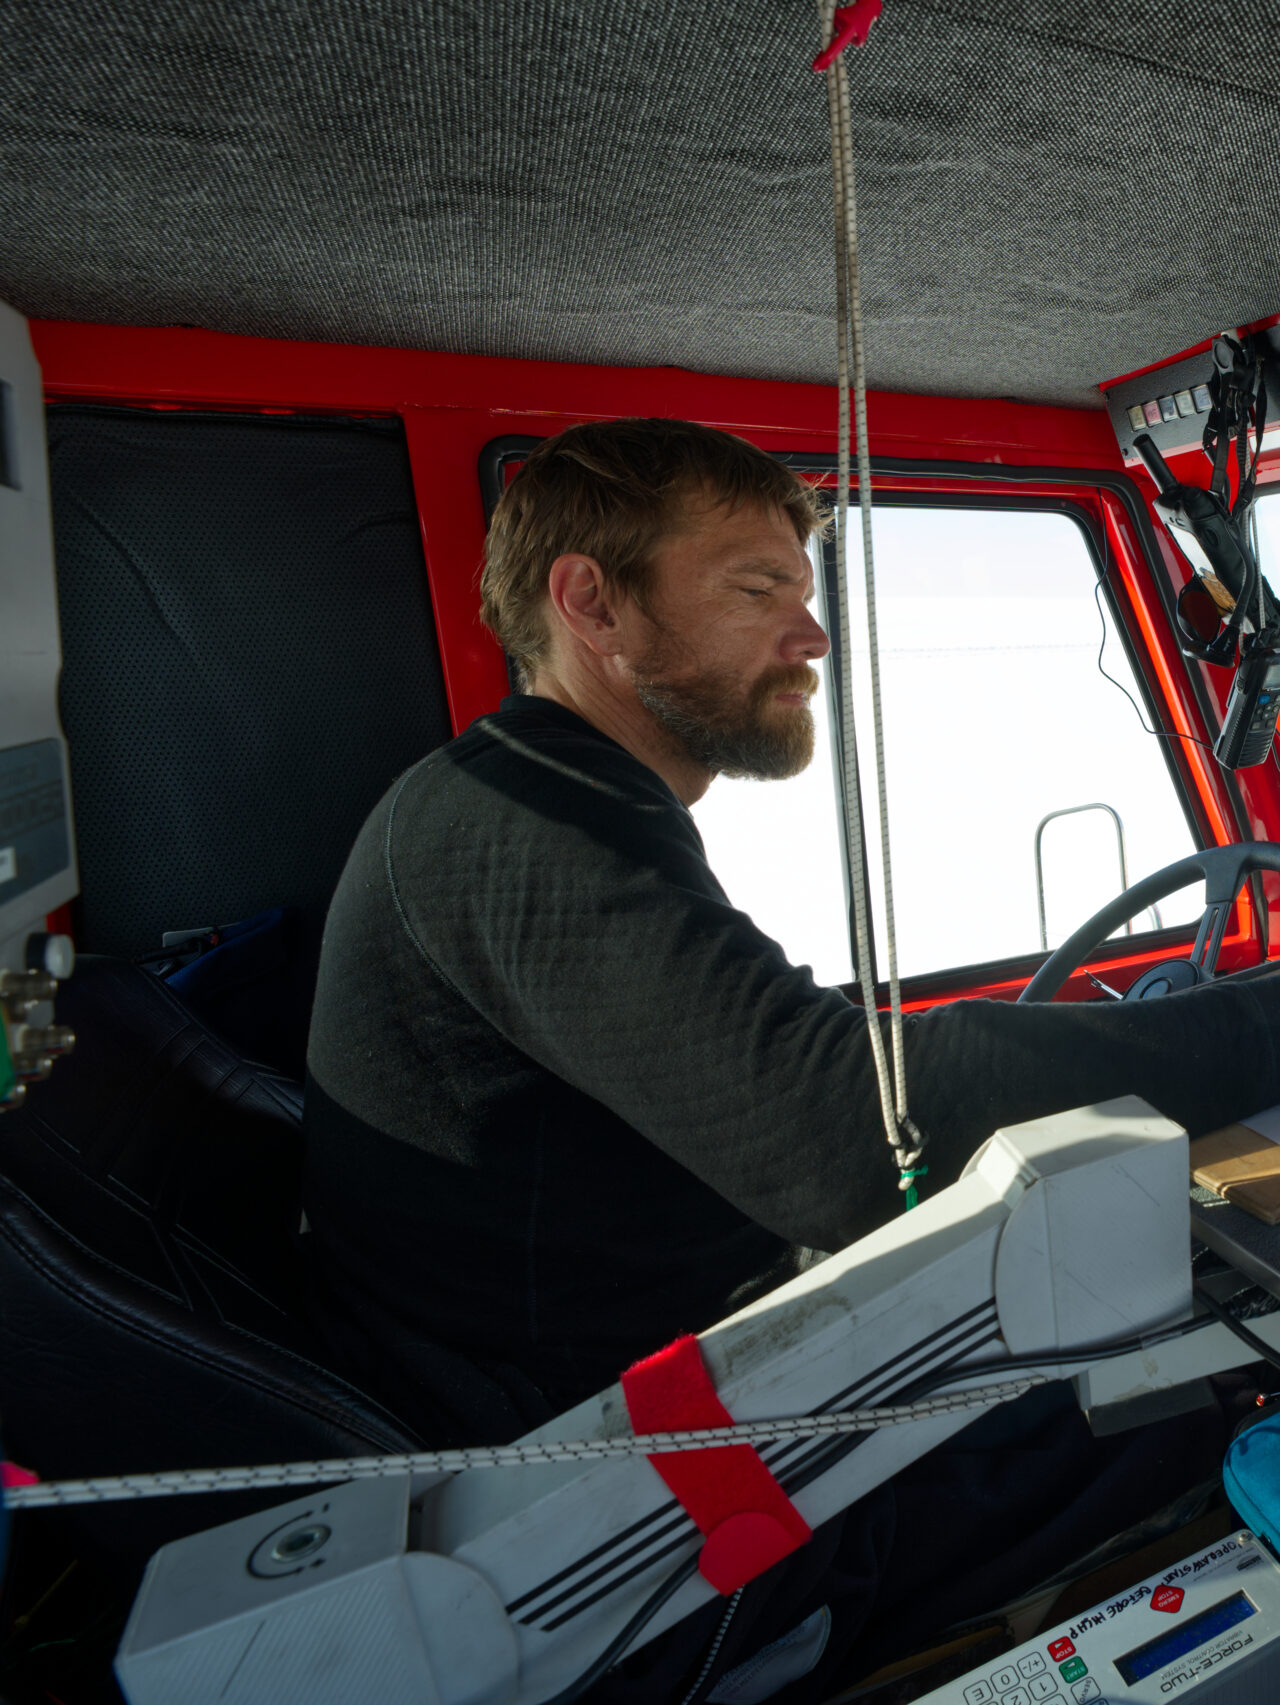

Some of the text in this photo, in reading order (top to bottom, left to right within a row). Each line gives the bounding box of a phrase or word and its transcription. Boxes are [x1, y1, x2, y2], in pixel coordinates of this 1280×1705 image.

[1108, 1586, 1152, 1618] BEFORE
[1158, 1590, 1174, 1601] STOP
[1158, 1594, 1180, 1608] EMERG
[1070, 1627, 1078, 1639] P
[1056, 1646, 1073, 1659] STOP
[1161, 1630, 1244, 1681] VIBRATOR CONTROL SYSTEM
[1160, 1633, 1254, 1693] FORCE-TWO
[1000, 1674, 1010, 1686] 0
[1066, 1666, 1085, 1680] START
[1040, 1682, 1048, 1692] 1
[1080, 1679, 1092, 1703] SERVO
[972, 1687, 984, 1702] E
[1010, 1694, 1024, 1705] 2
